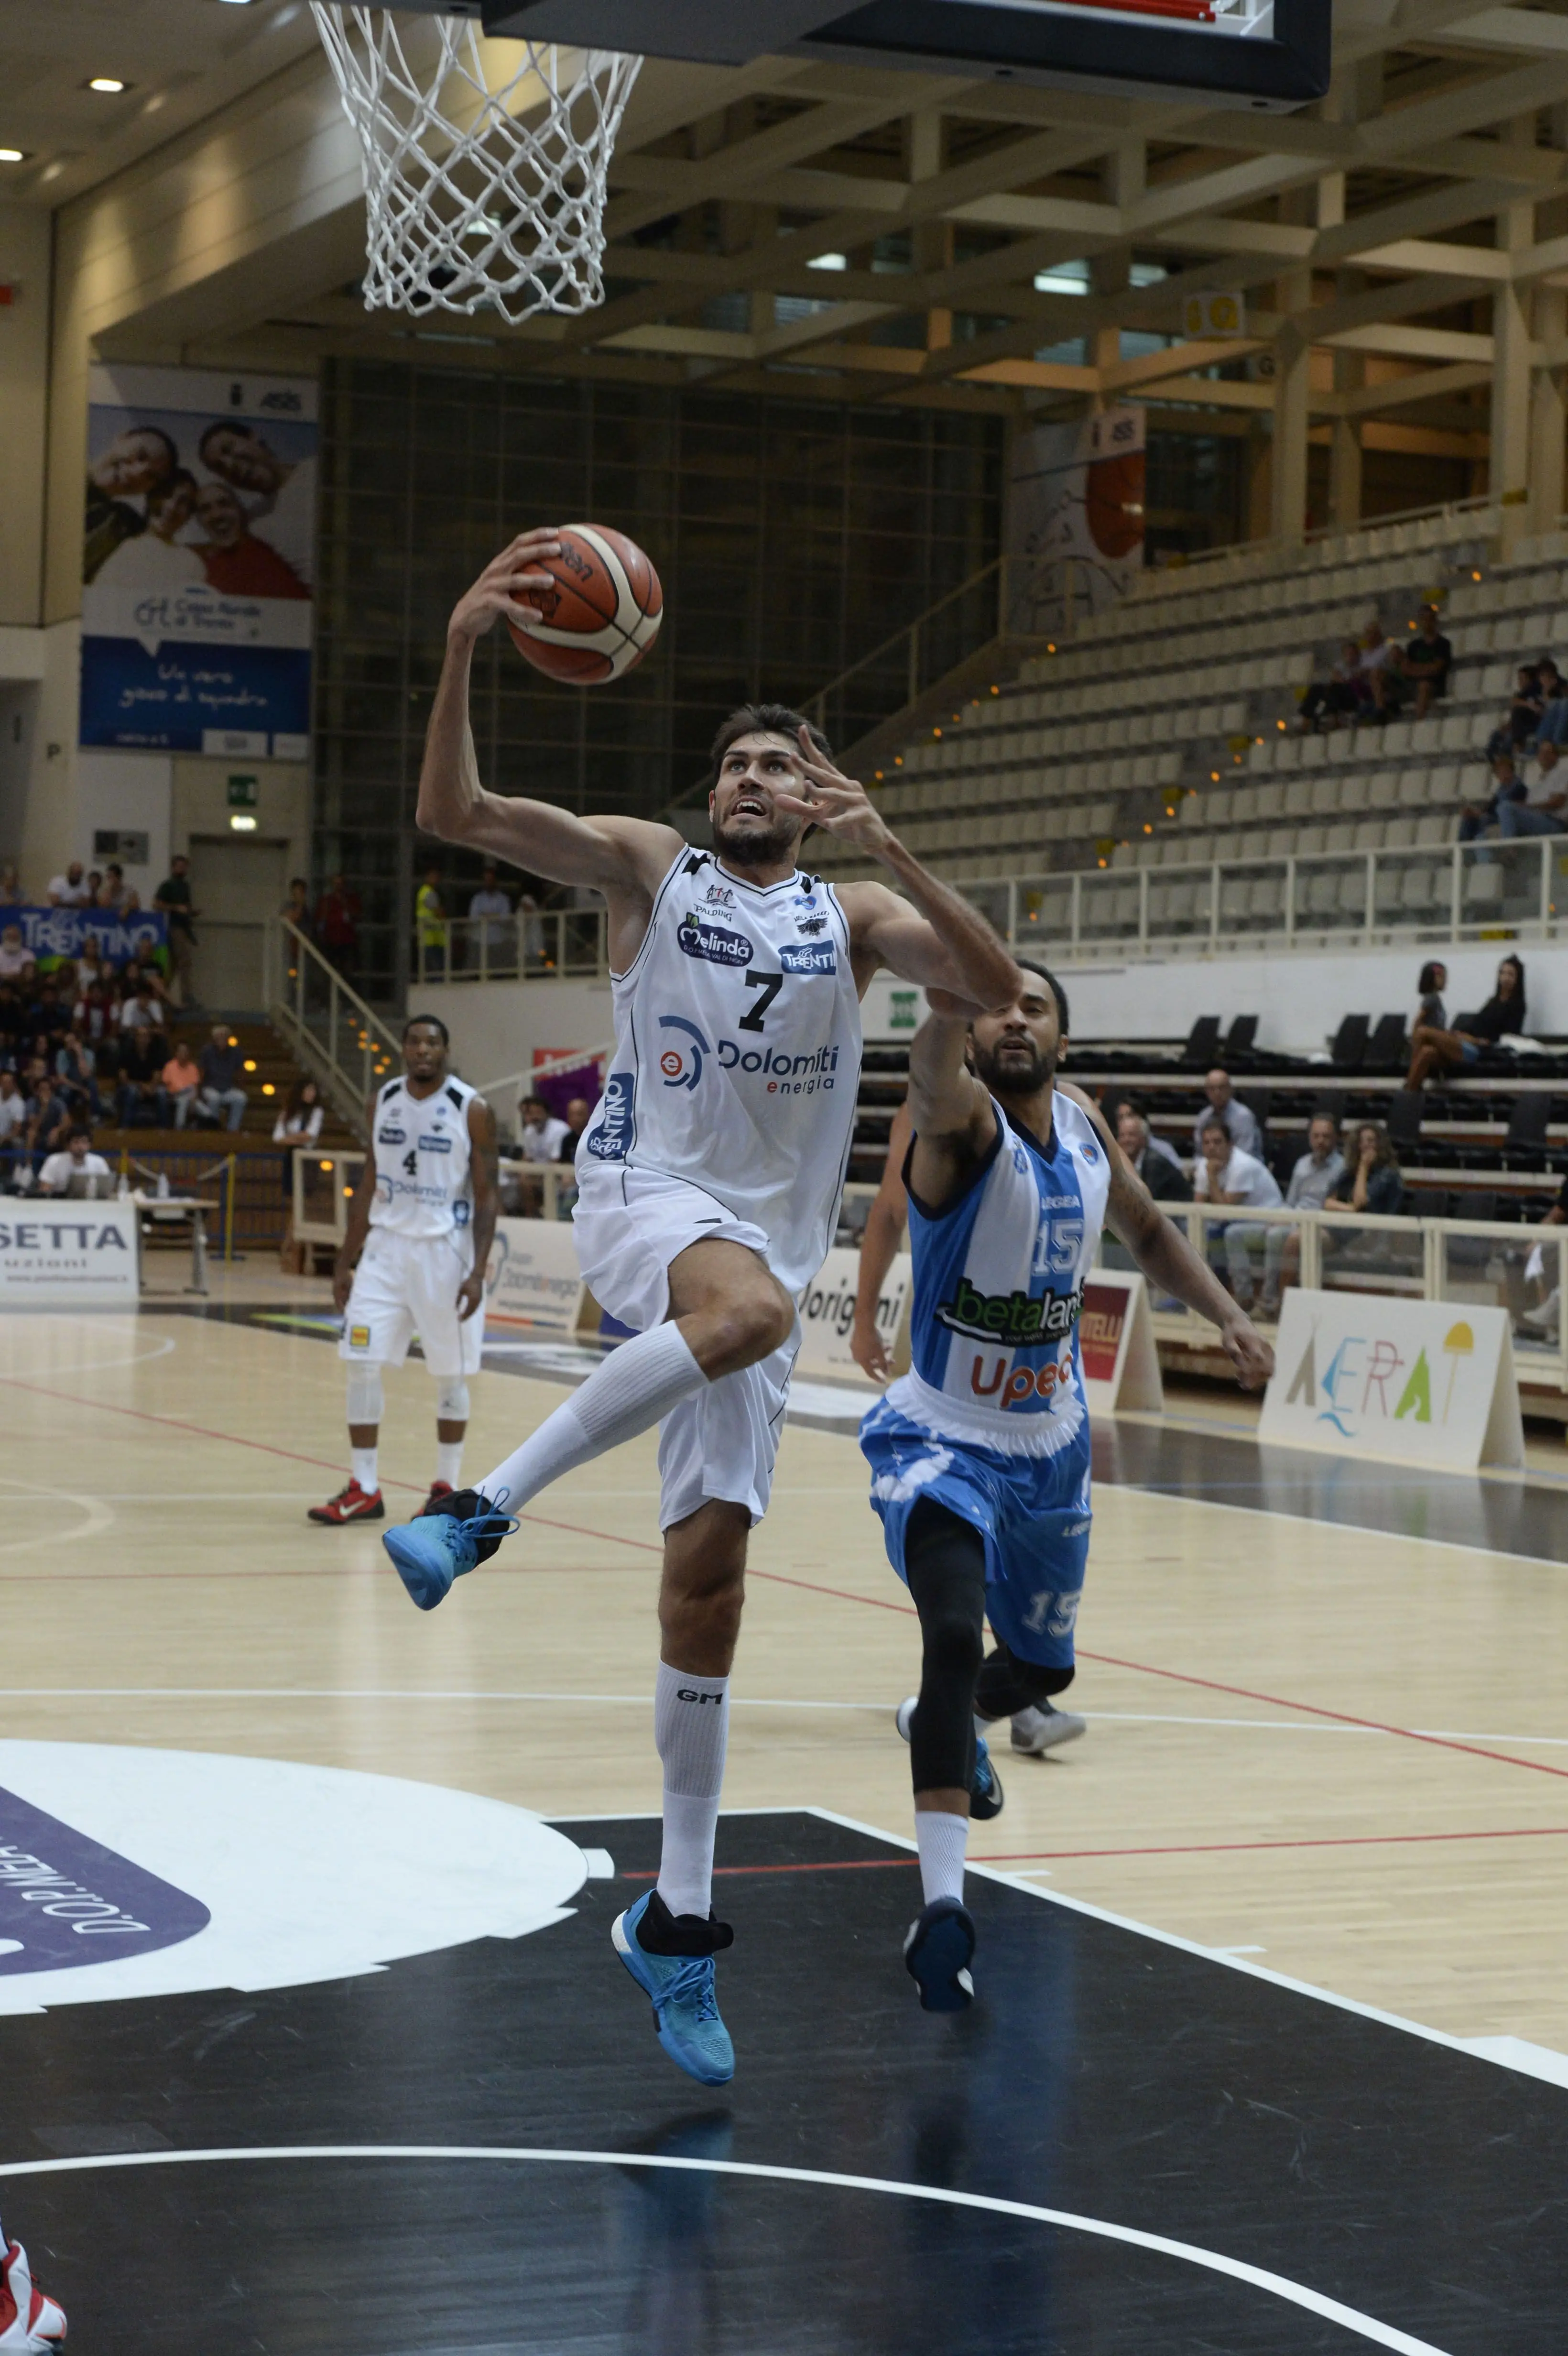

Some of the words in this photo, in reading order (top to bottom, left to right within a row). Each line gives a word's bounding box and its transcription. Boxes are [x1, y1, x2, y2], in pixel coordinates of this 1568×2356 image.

[20, 912, 159, 957] TRENTINO
[680, 927, 750, 959] Melinda
[782, 950, 836, 970] TRENTI
[739, 969, 783, 1033] 7
[718, 1039, 839, 1076] Dolomiti
[767, 1077, 835, 1095] energia
[403, 1149, 417, 1176] 4
[1033, 1219, 1085, 1277] 15
[799, 1277, 906, 1336] origni
[1021, 1590, 1082, 1638] 15
